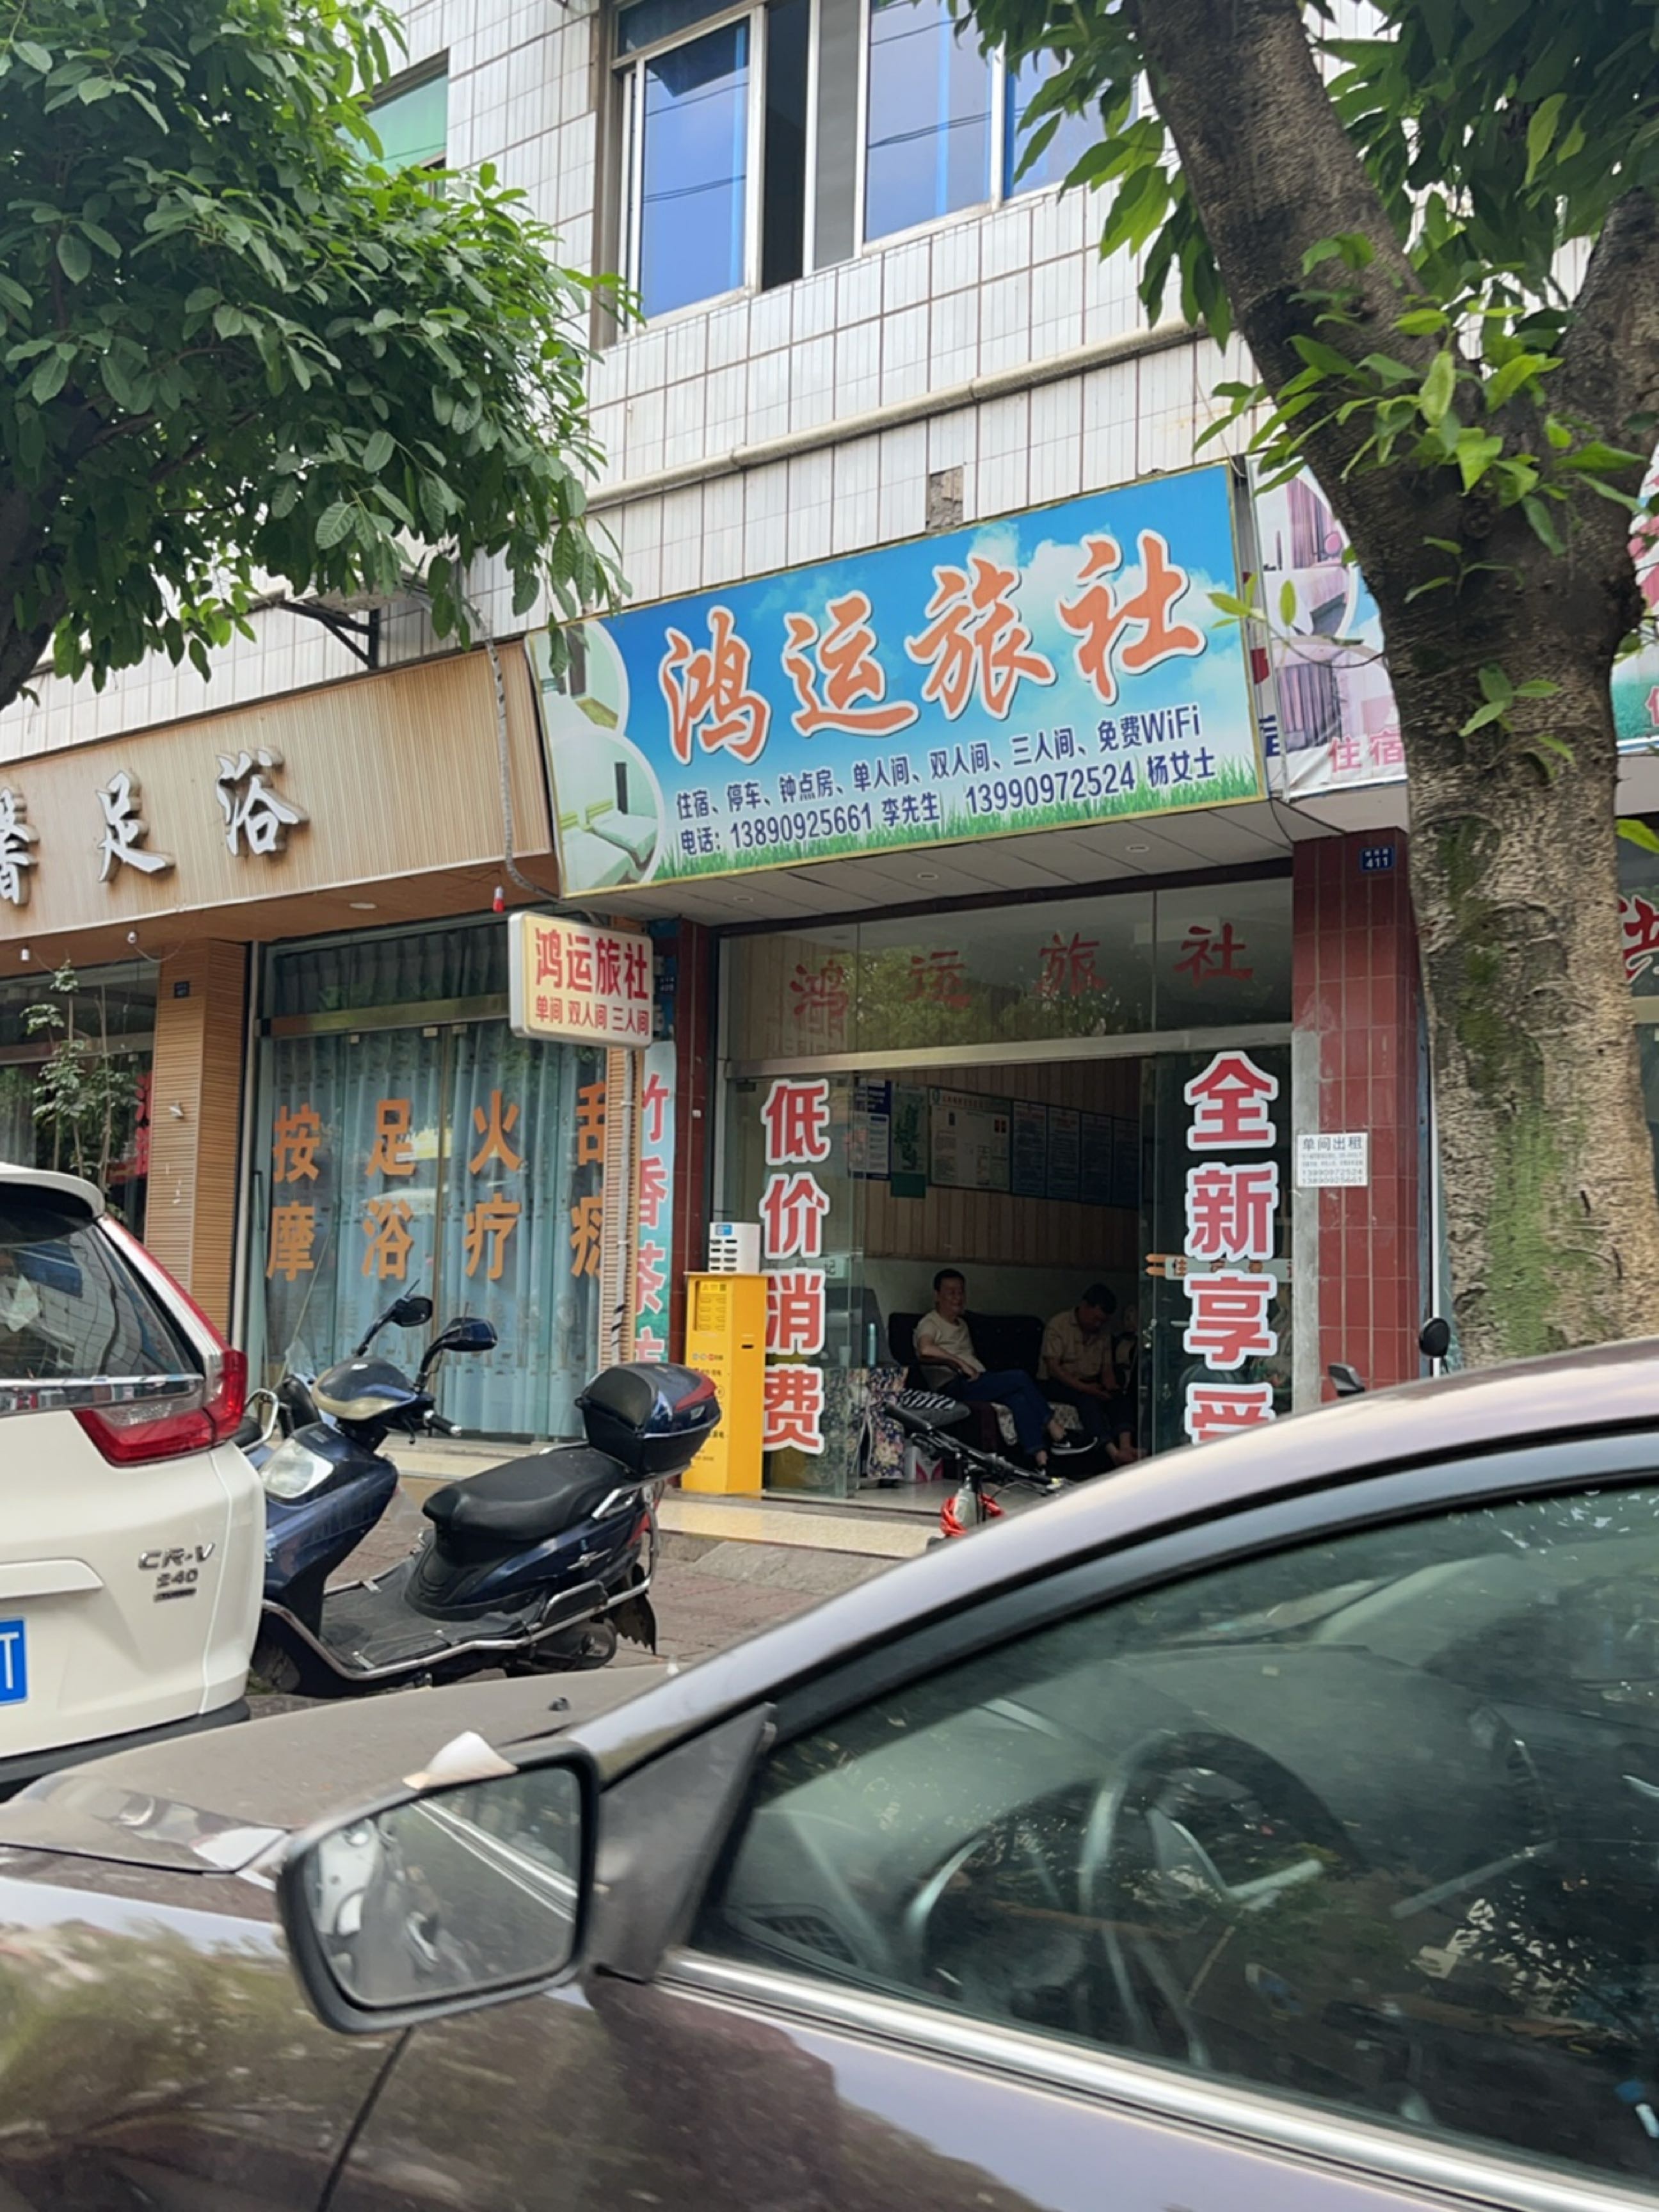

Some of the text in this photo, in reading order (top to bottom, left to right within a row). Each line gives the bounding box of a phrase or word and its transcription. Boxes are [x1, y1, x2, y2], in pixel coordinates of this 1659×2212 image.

[658, 528, 1206, 765] 鸿运旅社
[881, 791, 942, 827] 李先生
[965, 760, 1136, 815] 13990972524
[1147, 746, 1216, 788] 杨女士
[1328, 728, 1404, 773] 住宿
[535, 927, 649, 1000] 鸿运旅社
[535, 995, 650, 1036] 单间 双人间 三人间
[1302, 1136, 1362, 1151] 单间出租
[266, 1103, 322, 1280] 按摩
[361, 1098, 417, 1280] 足浴
[465, 1090, 524, 1280] 火疗
[760, 1079, 830, 1454] 低价消费
[138, 1542, 216, 1570] CR-V
